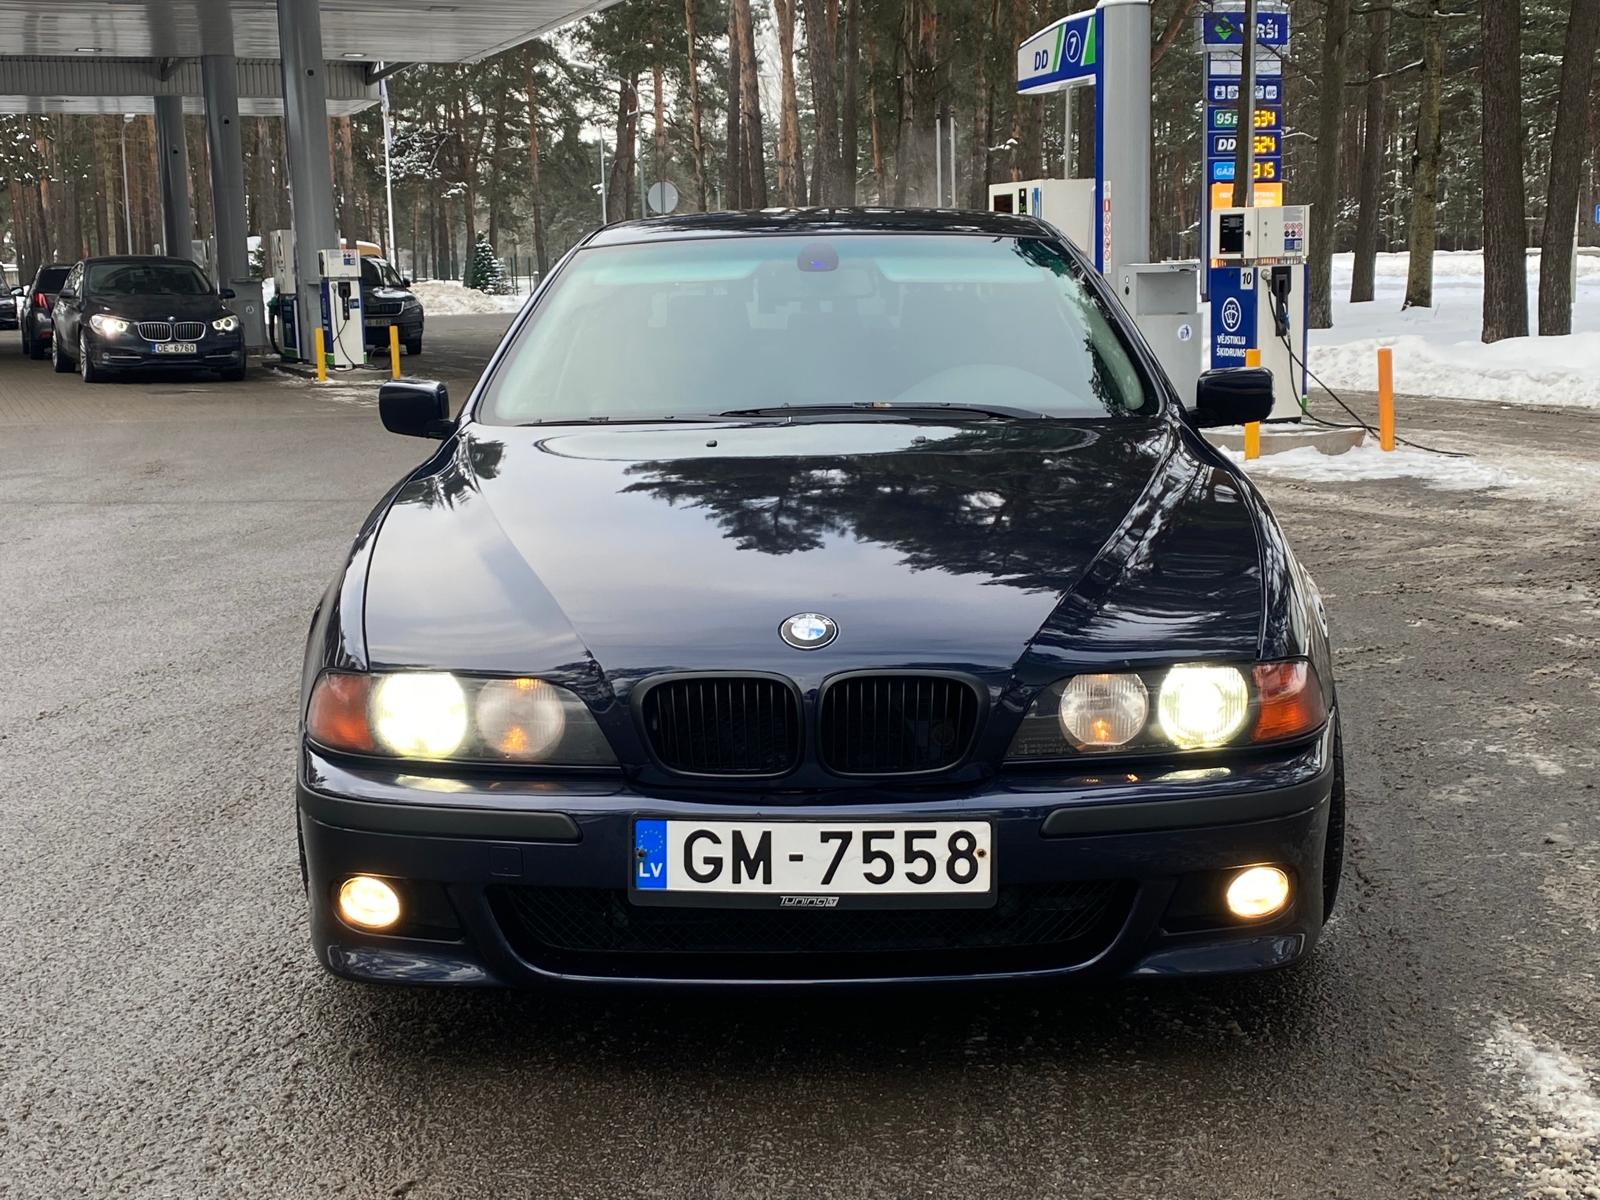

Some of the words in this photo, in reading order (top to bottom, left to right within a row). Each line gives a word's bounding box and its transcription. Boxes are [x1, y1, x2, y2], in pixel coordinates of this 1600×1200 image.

[1240, 18, 1279, 39] RŠI
[1069, 37, 1077, 56] 7
[1034, 50, 1049, 71] DD
[1217, 138, 1237, 151] DD
[1242, 272, 1252, 285] 10
[638, 862, 663, 878] LV
